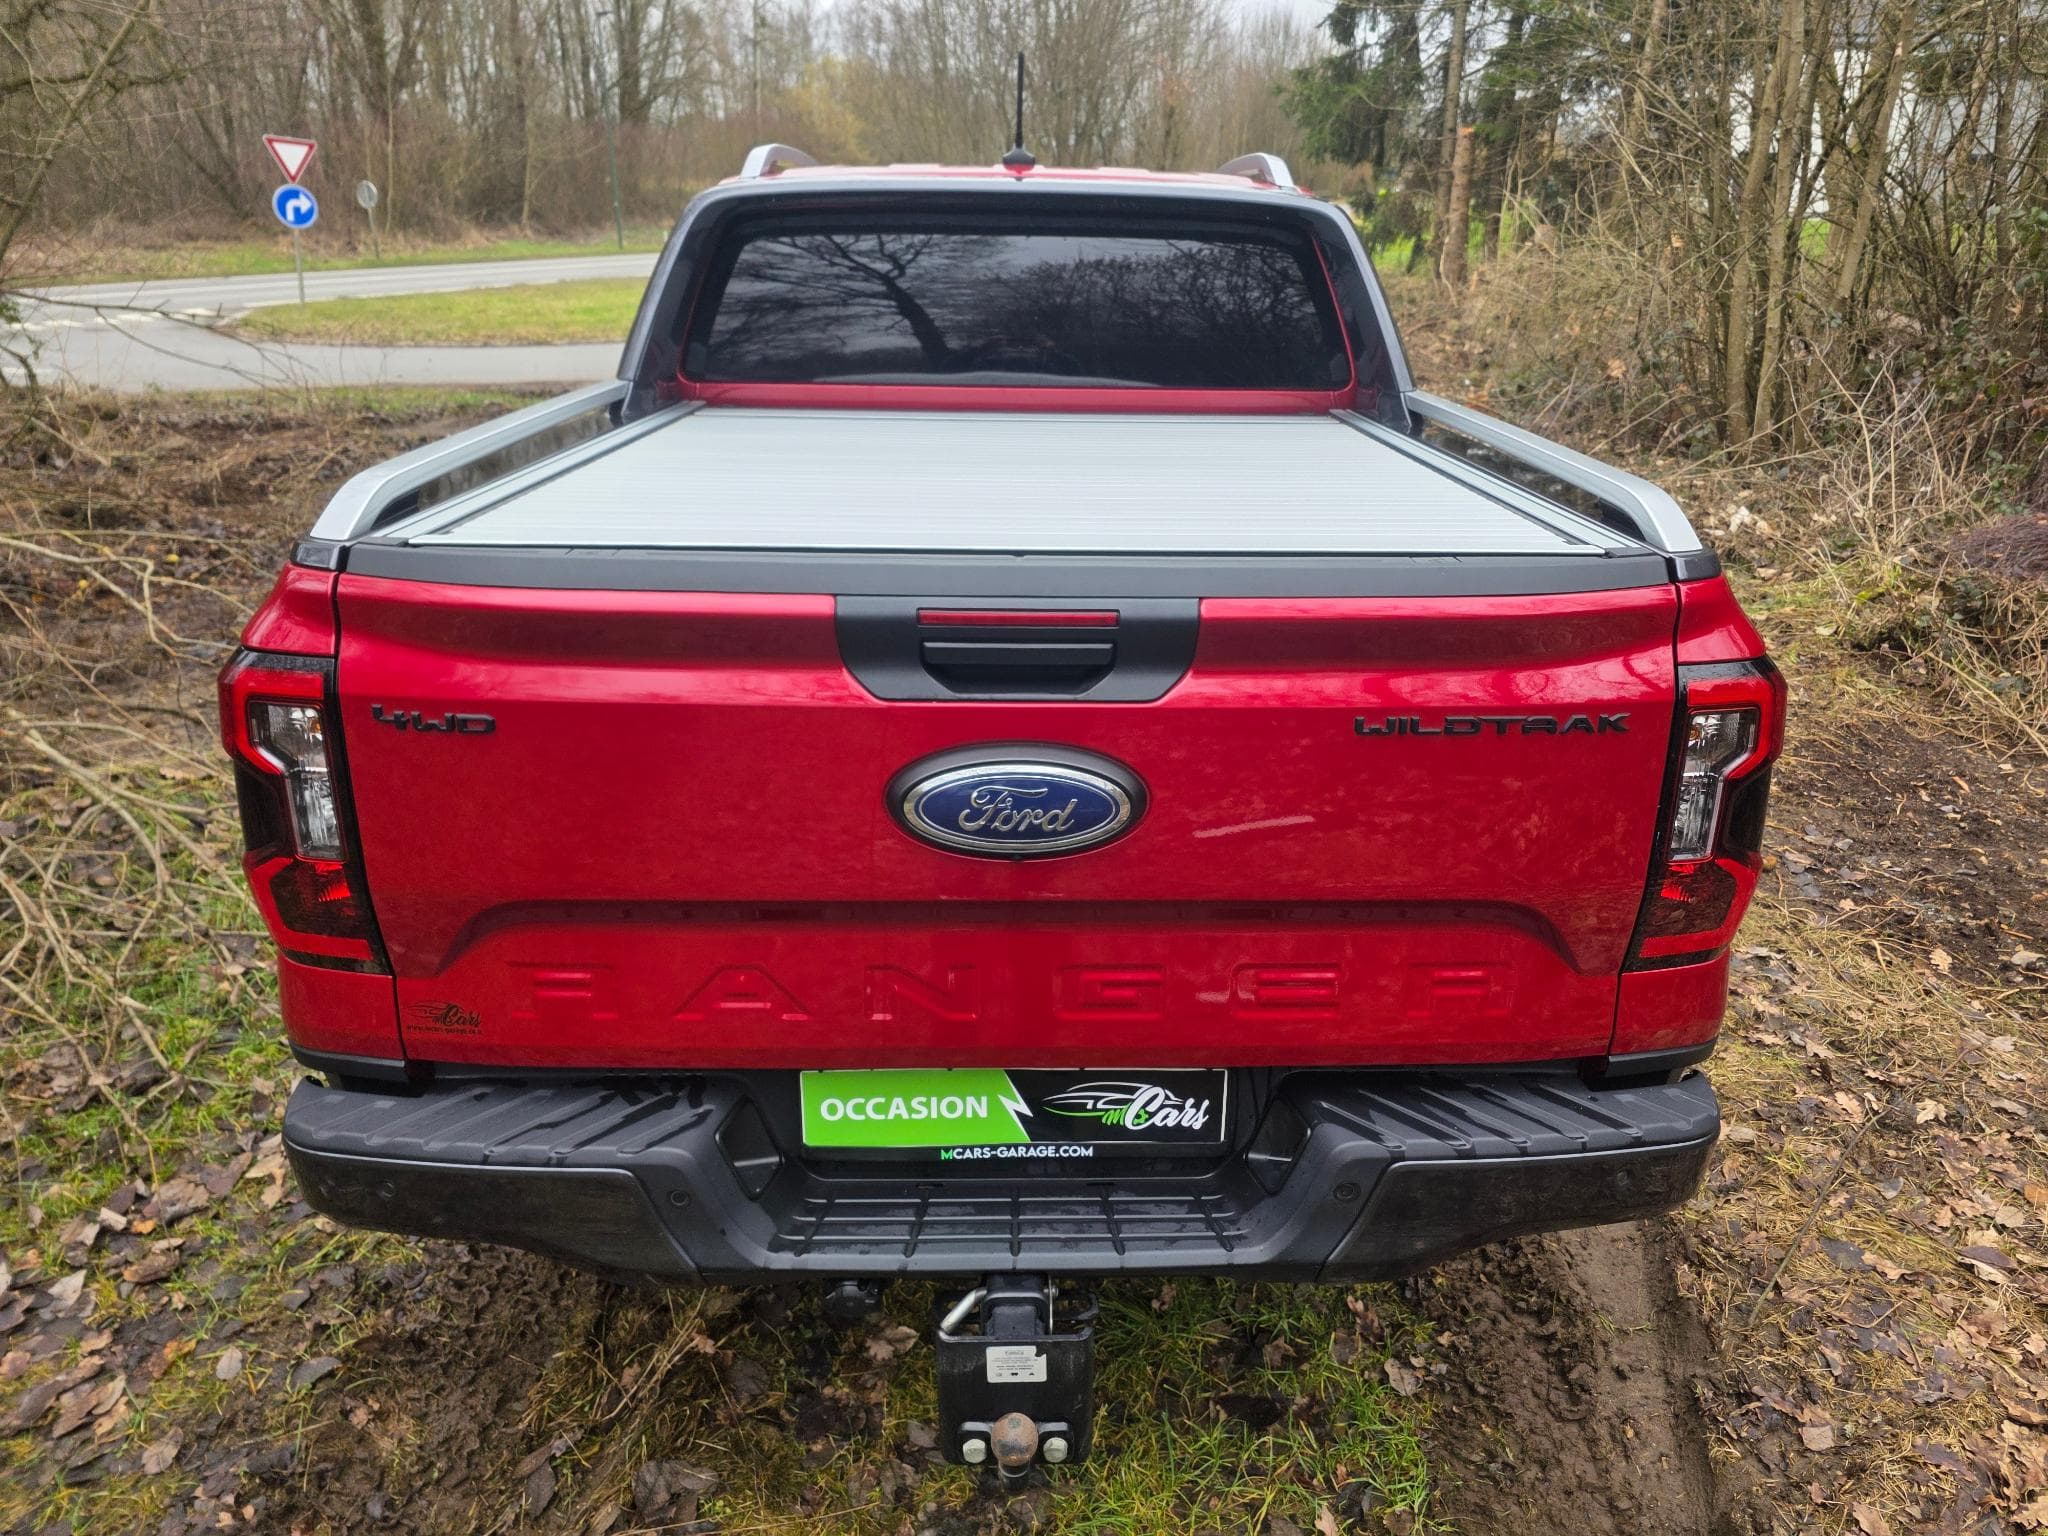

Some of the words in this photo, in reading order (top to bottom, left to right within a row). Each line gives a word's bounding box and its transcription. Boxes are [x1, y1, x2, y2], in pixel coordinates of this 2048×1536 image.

[371, 703, 497, 734] 4WD
[1354, 712, 1632, 737] WILDTRAK
[958, 785, 1079, 833] Ford
[505, 961, 1515, 1021] RANGER
[819, 1094, 989, 1122] OCCASION
[940, 1145, 1094, 1161] MCARS-GARAGE.COM
